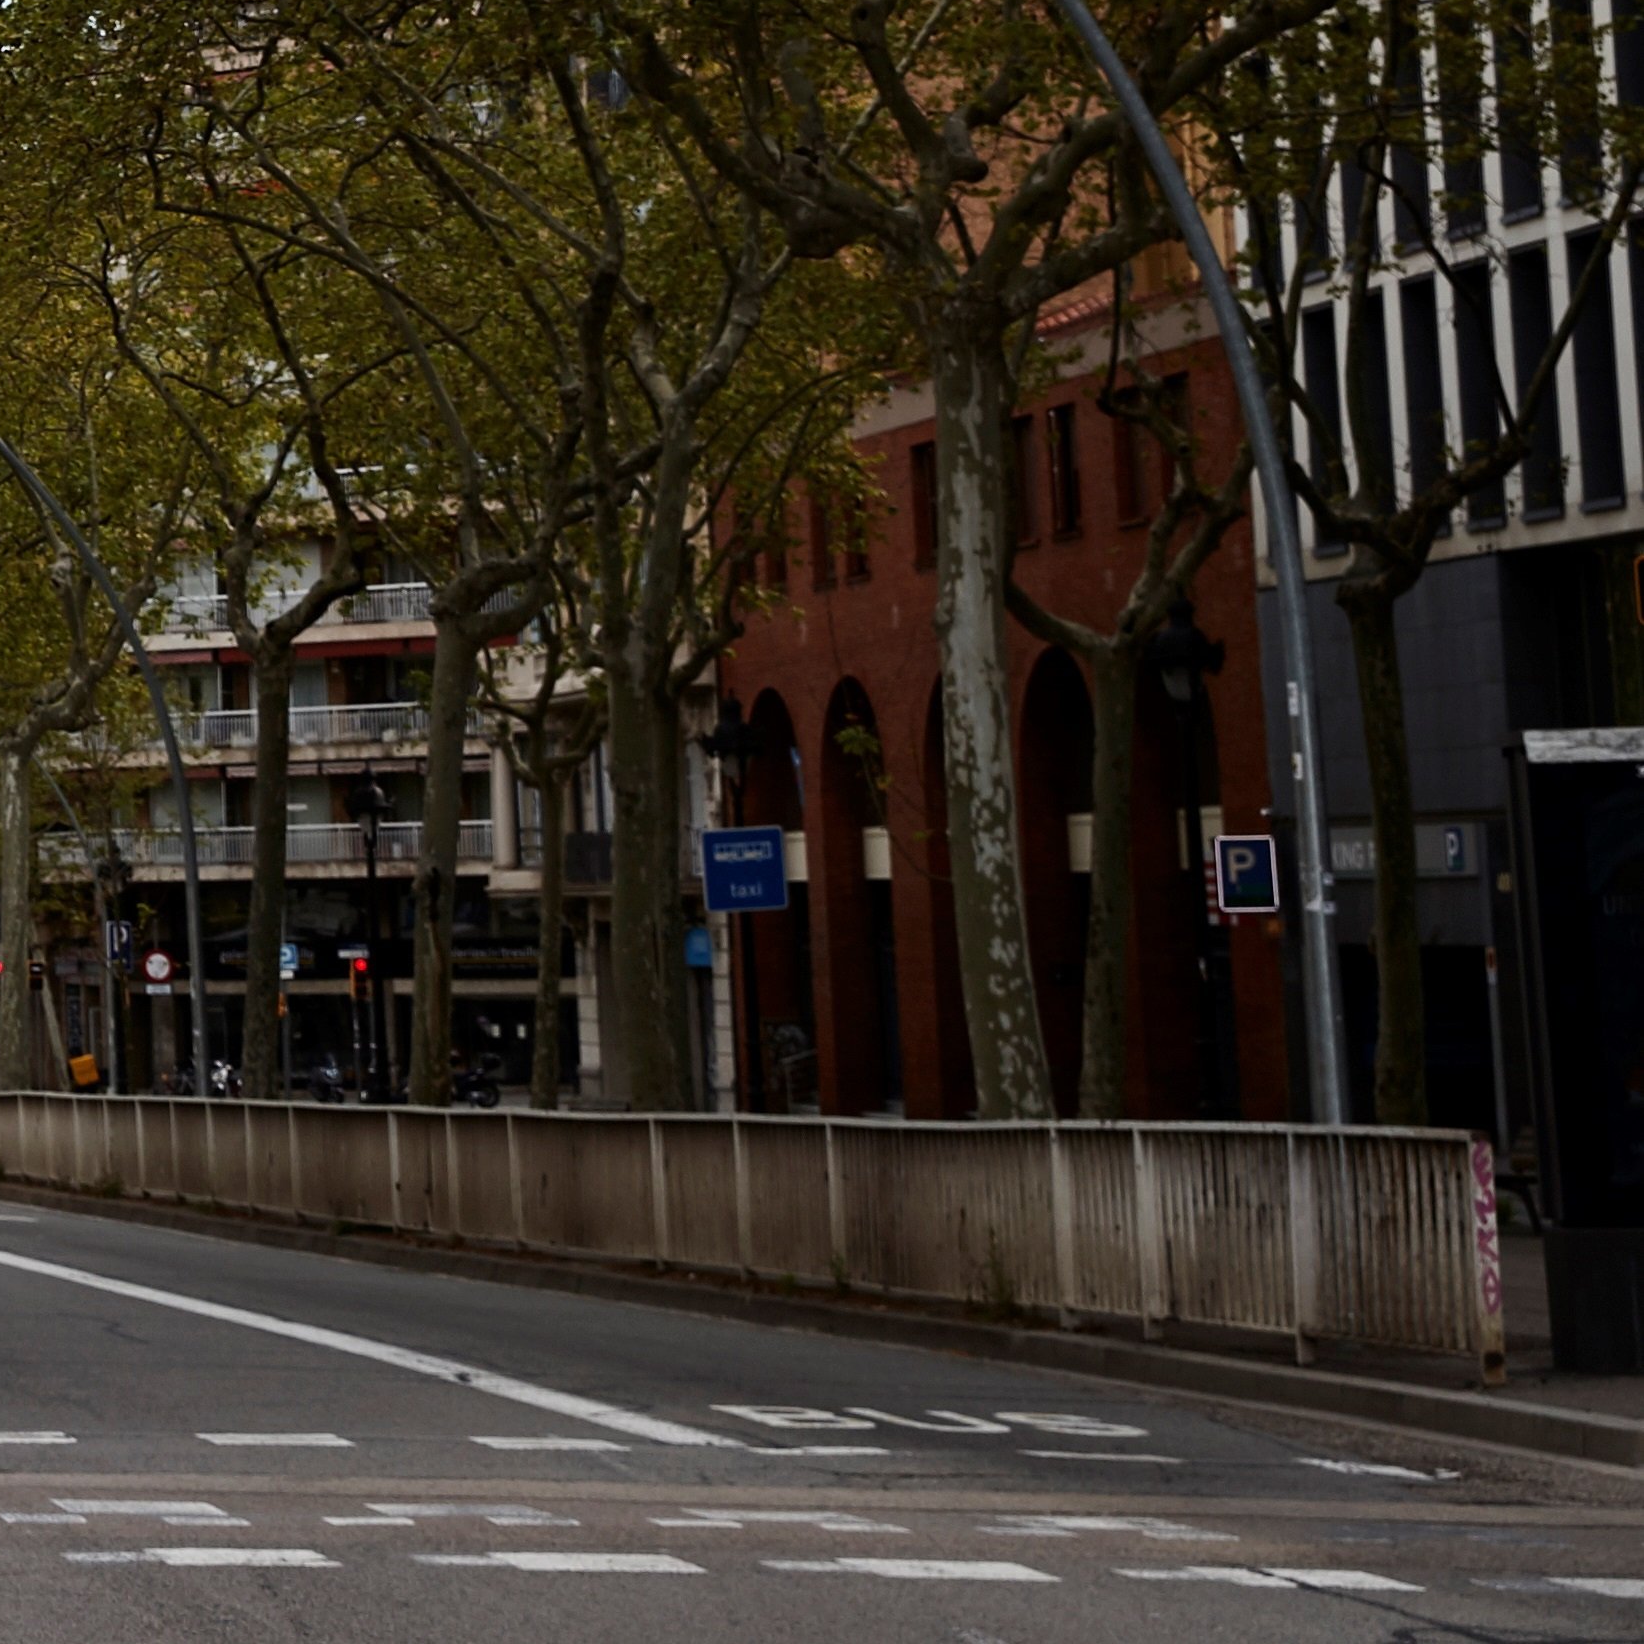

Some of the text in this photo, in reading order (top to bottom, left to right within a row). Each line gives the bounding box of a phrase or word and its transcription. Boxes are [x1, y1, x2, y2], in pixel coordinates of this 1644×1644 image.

[1226, 845, 1257, 885] P
[1446, 831, 1460, 869] P
[729, 881, 764, 899] taxi
[708, 1403, 1149, 1438] BUS
